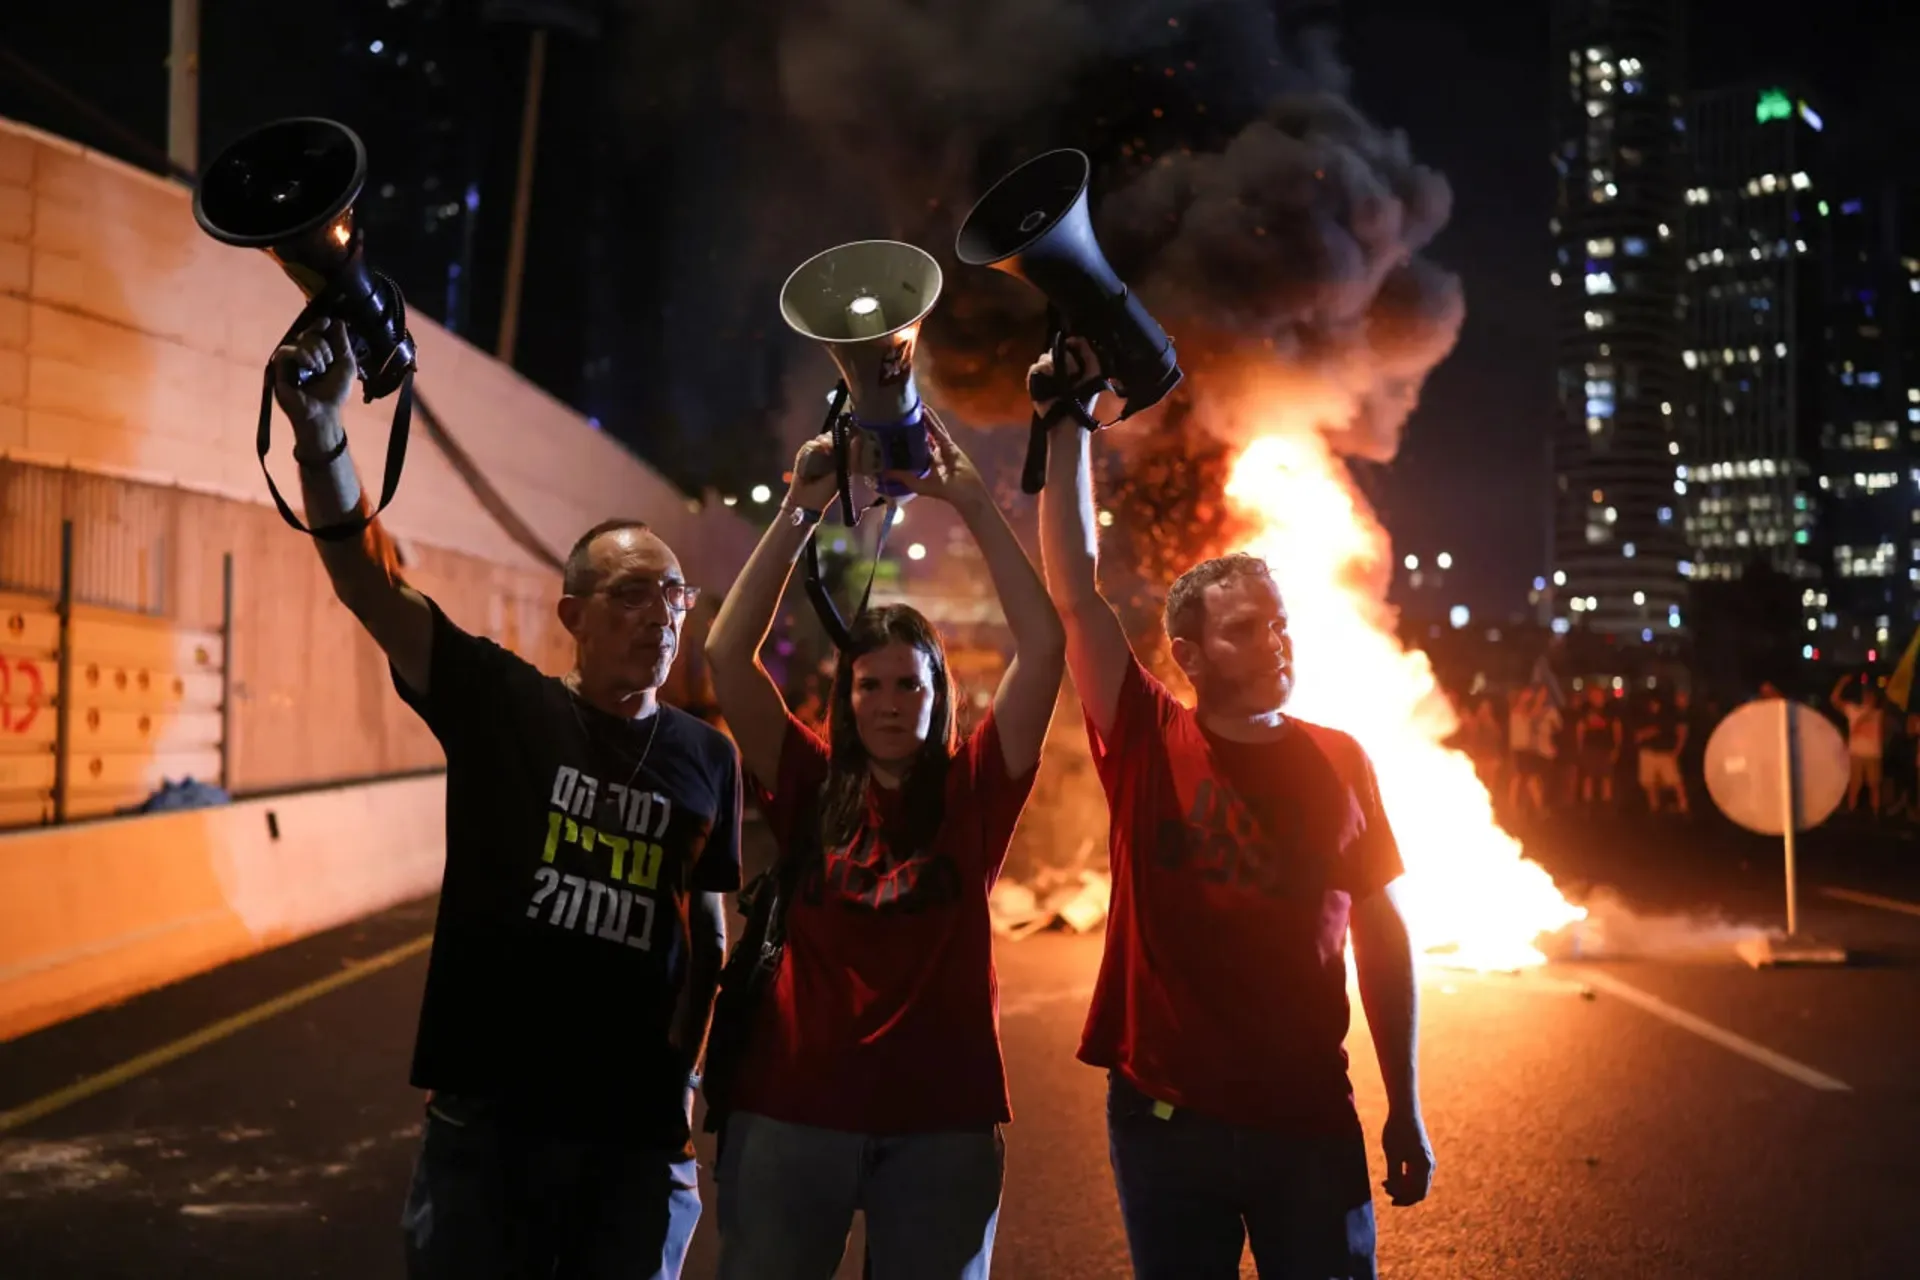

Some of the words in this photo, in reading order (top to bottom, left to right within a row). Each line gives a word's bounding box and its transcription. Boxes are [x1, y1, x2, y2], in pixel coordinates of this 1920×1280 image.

[550, 765, 599, 819] הם
[541, 811, 663, 890] עדיין
[526, 866, 656, 951] בעזה?
